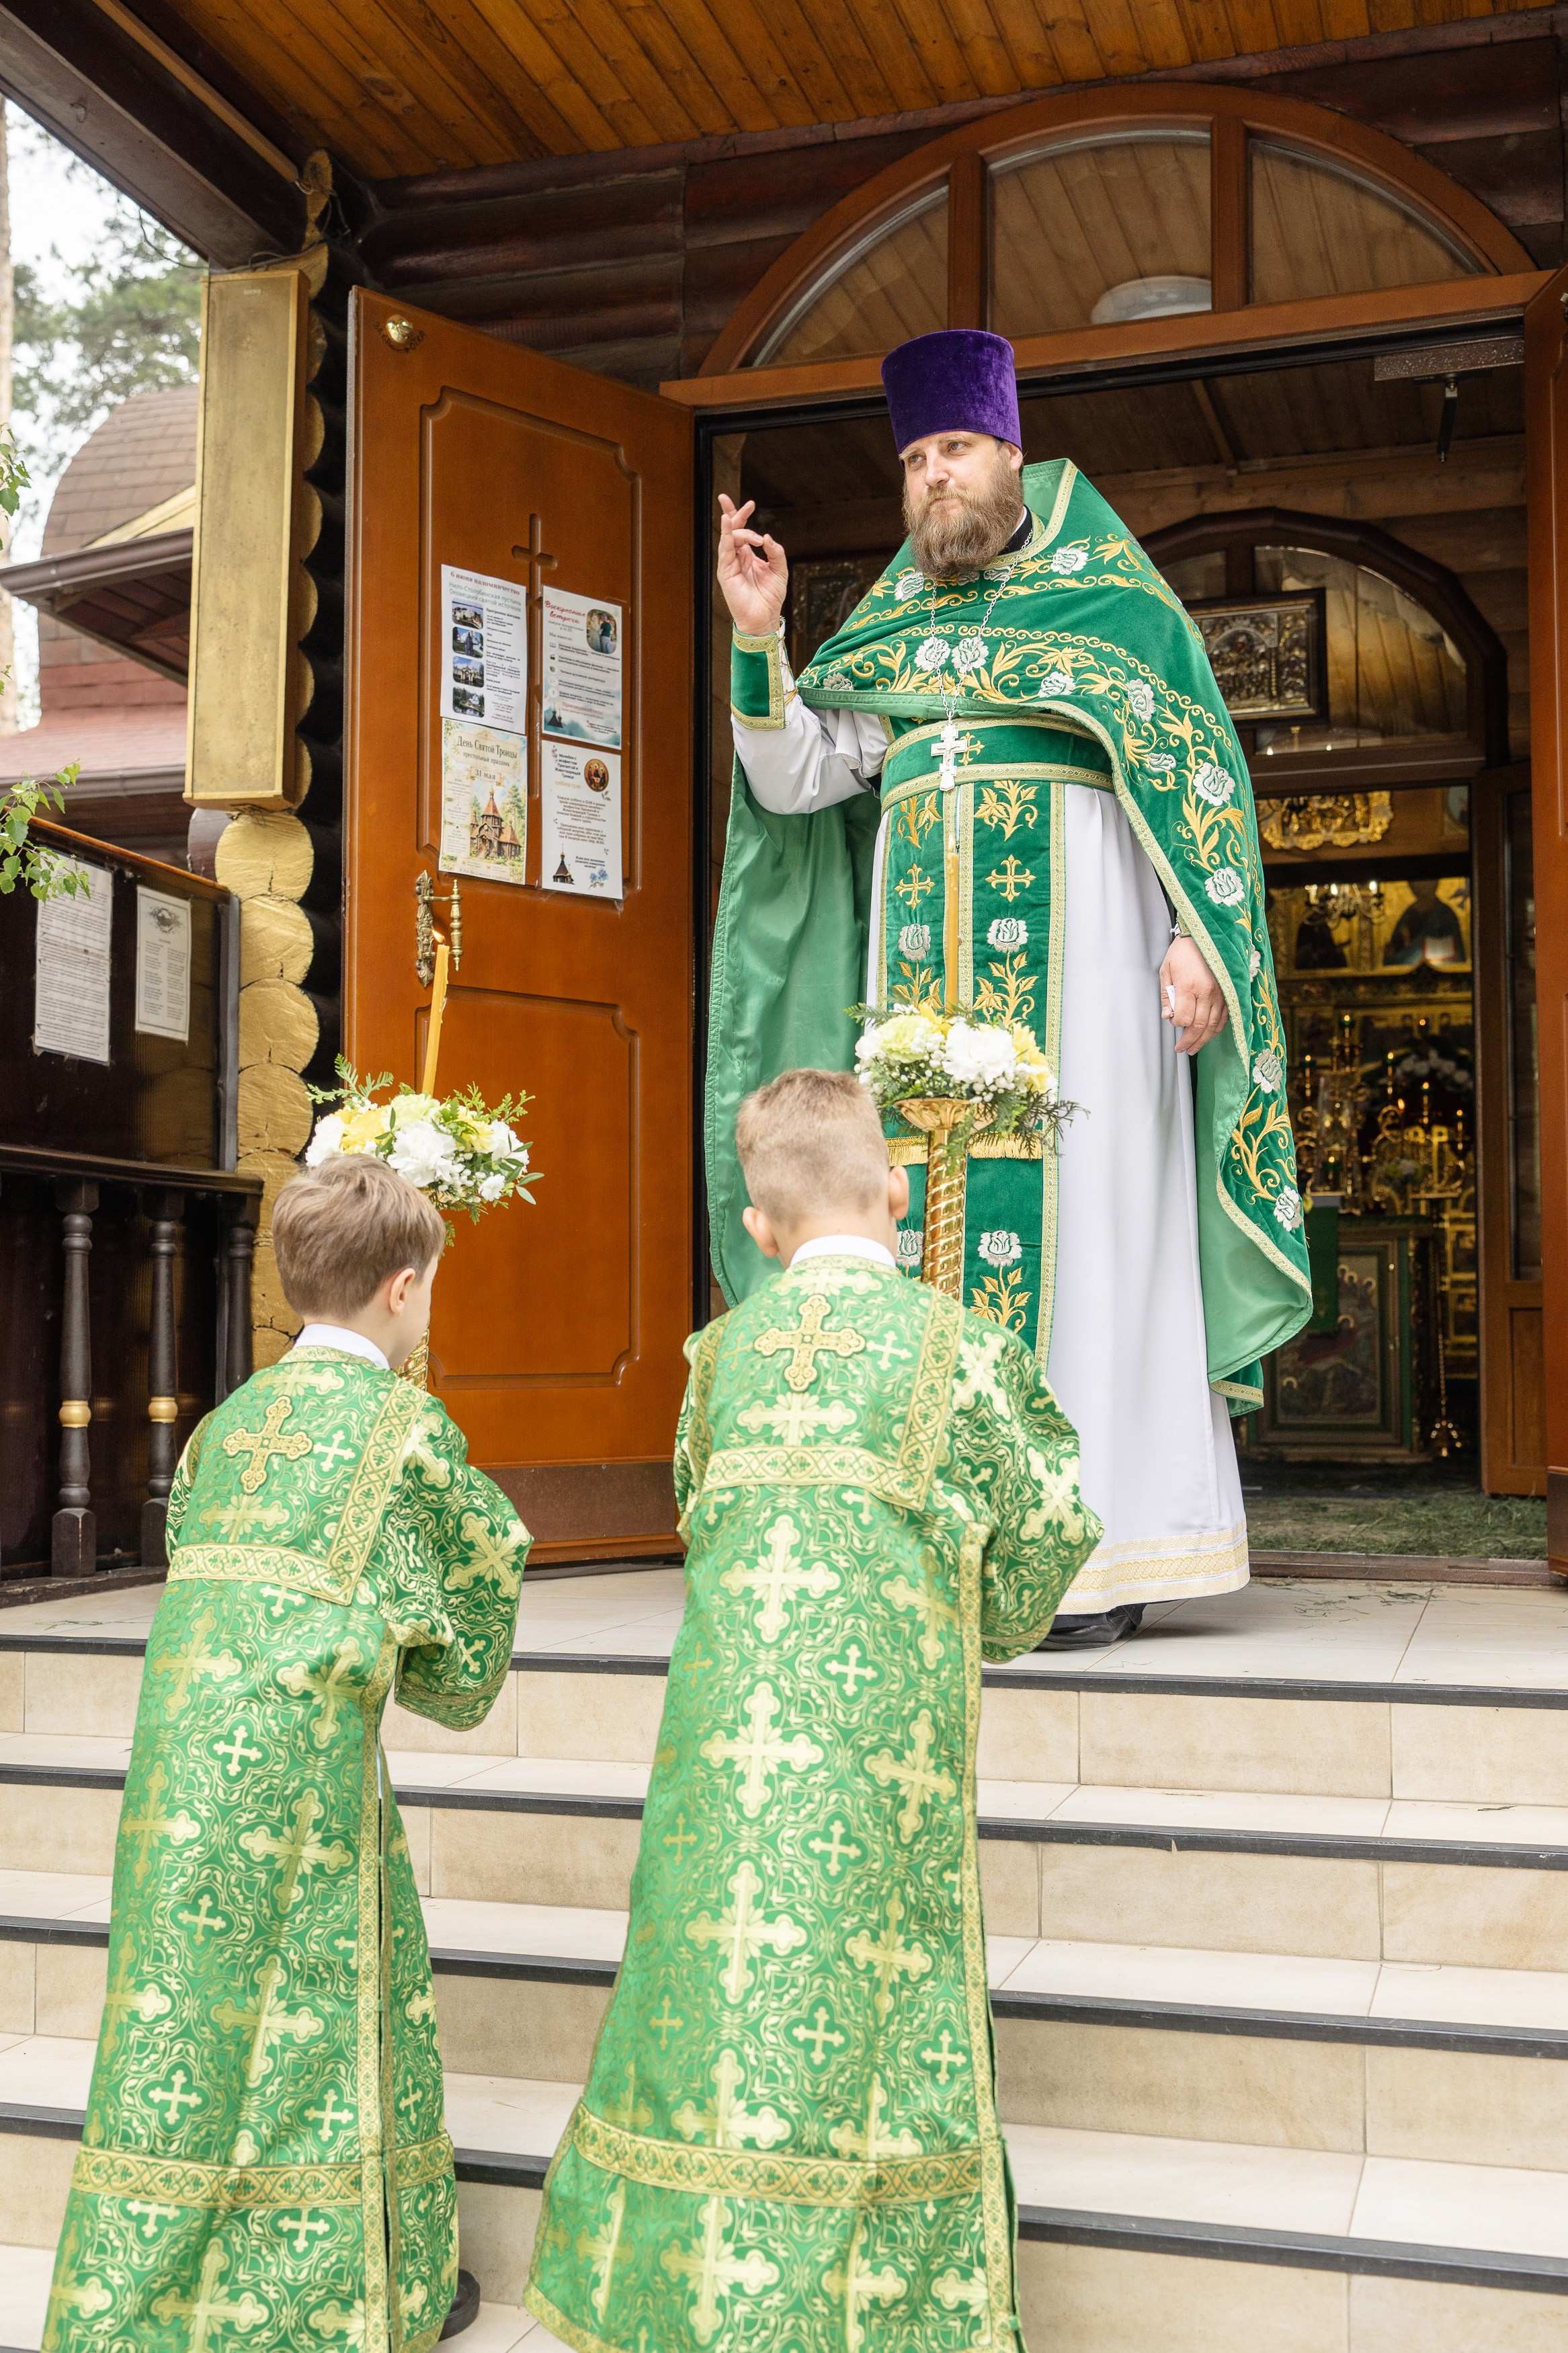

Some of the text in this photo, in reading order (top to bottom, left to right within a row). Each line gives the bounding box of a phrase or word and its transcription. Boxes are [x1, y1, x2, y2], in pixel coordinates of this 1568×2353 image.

[456, 574, 472, 582] июня
[474, 580, 520, 595] паломничество
[449, 588, 521, 612] Оковецкий святой источник
[545, 600, 585, 618] Воскресные
[550, 610, 580, 624] встречи
[457, 736, 517, 760] День Святой Троицы
[462, 752, 509, 768] престольный праздник
[474, 768, 481, 776] 31
[554, 768, 581, 776] Животворящей
